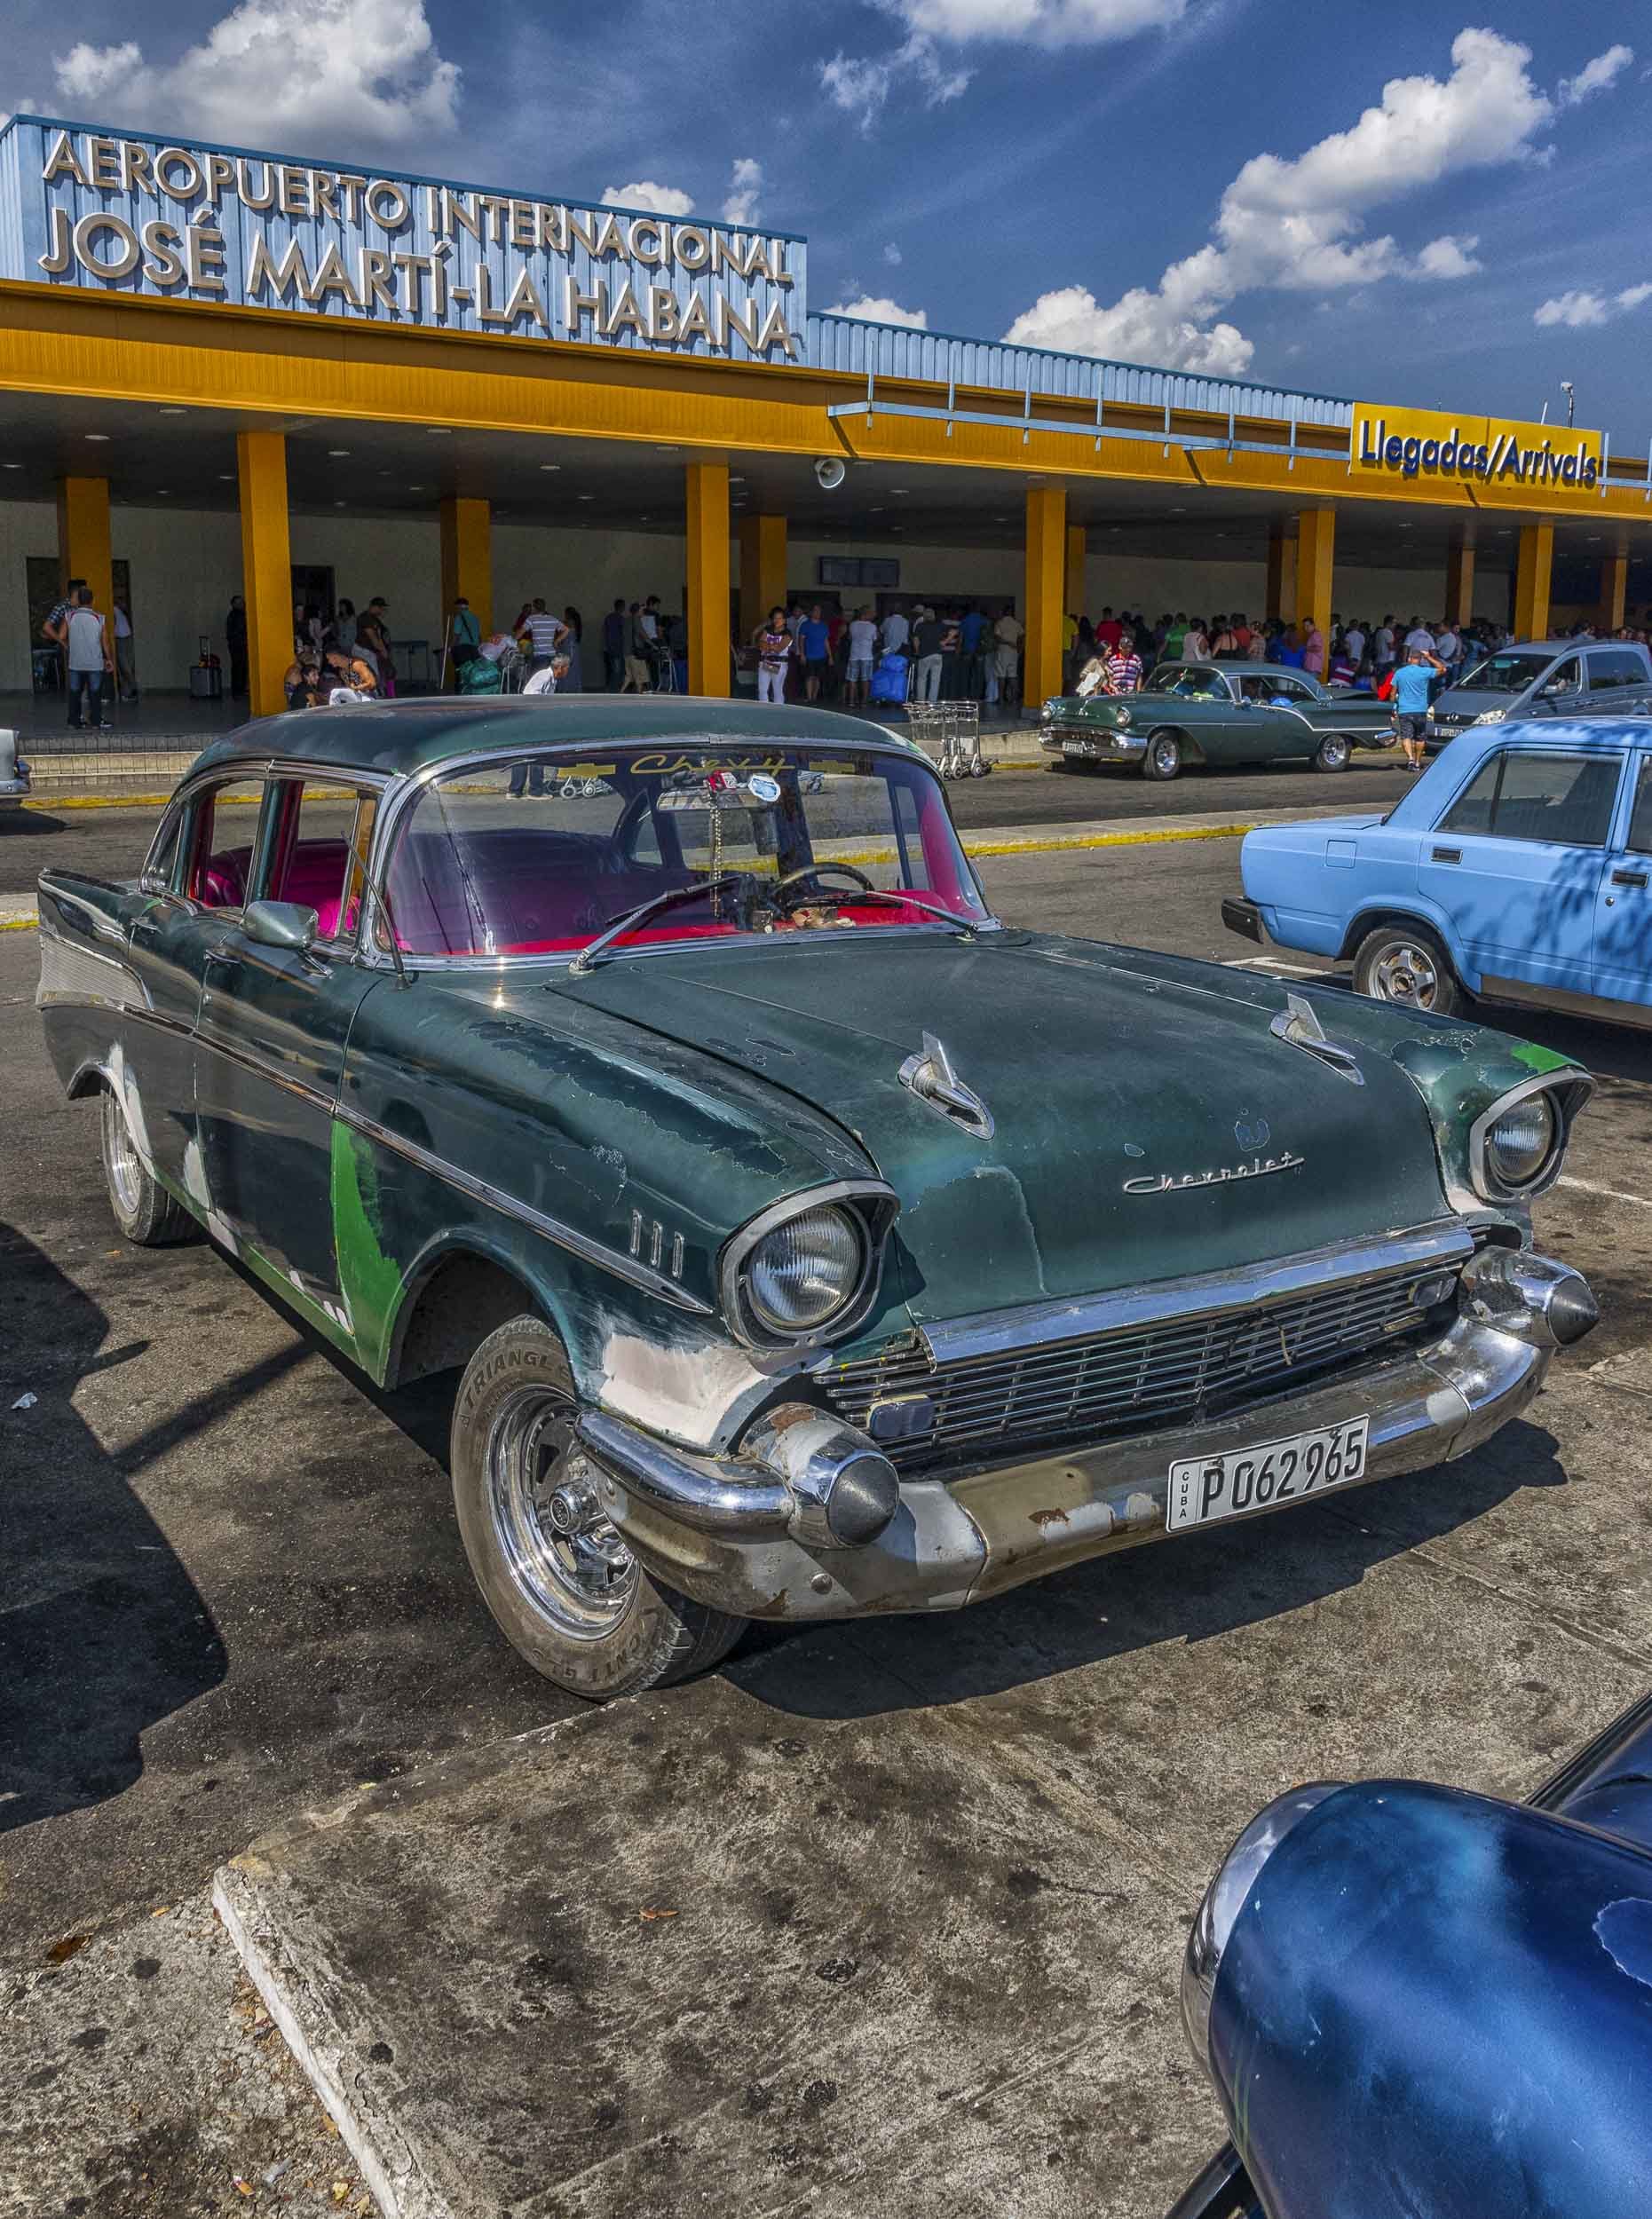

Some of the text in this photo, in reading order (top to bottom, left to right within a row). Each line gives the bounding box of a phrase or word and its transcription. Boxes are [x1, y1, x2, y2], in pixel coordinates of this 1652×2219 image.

[42, 130, 793, 282] AEROPUERTO INTERNACIONAL
[37, 207, 225, 291] JOSÉ
[565, 274, 796, 356] HABANA
[1358, 419, 1598, 484] Llegadas/Arrivals
[630, 754, 796, 778] Chevy
[1123, 1151, 1306, 1195] Chevrolet
[1178, 1470, 1191, 1520] CUBA
